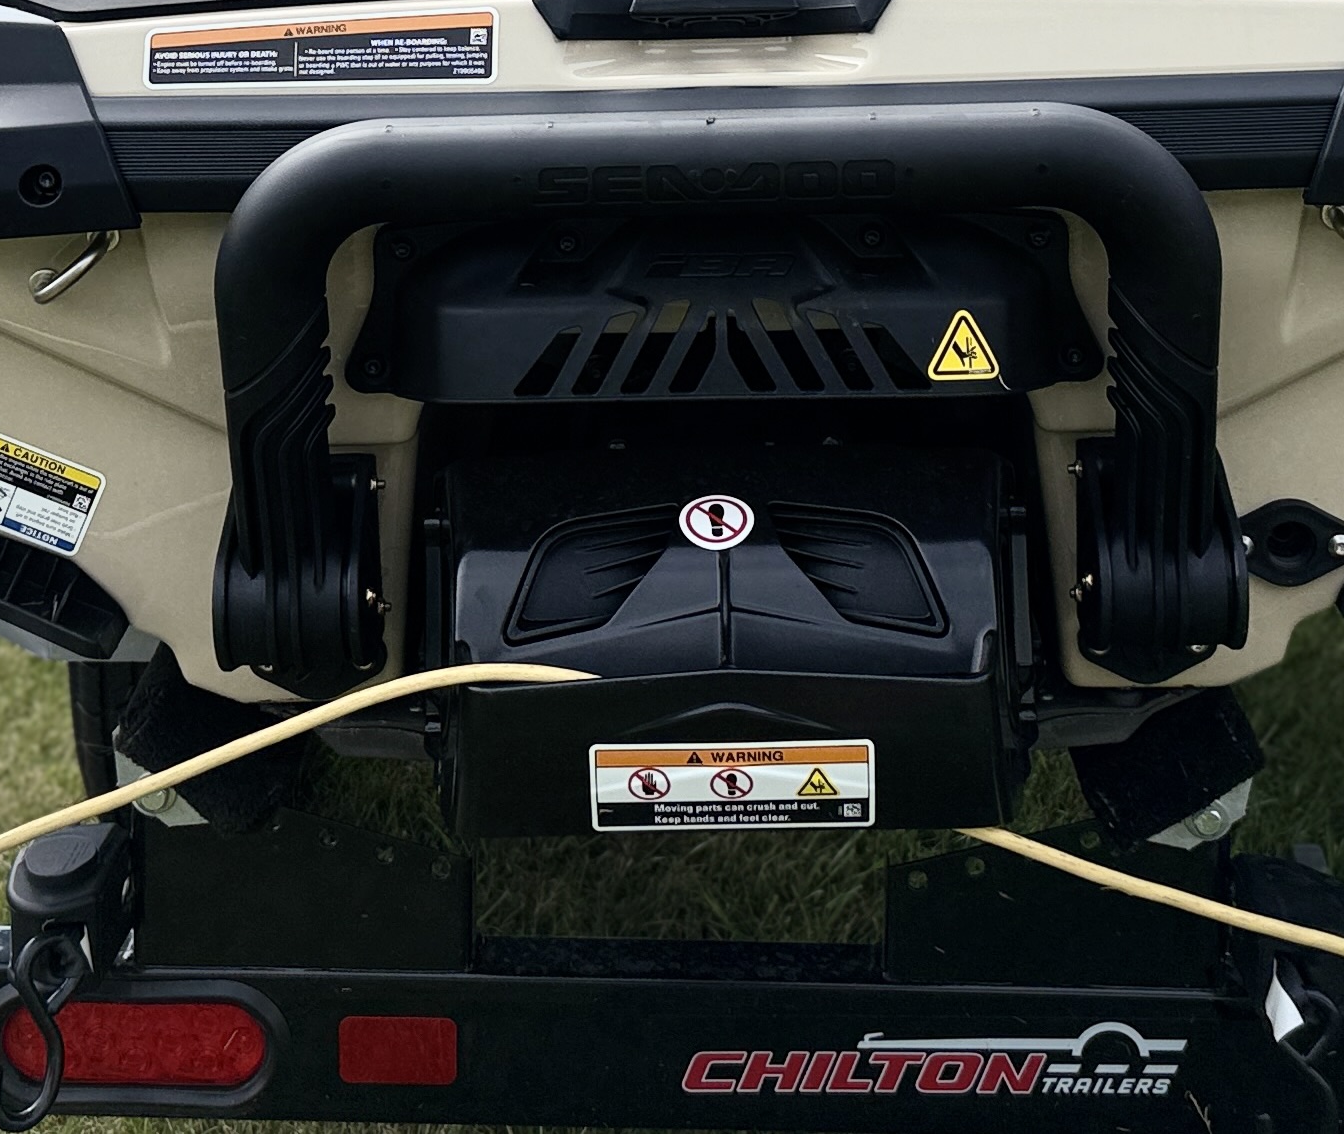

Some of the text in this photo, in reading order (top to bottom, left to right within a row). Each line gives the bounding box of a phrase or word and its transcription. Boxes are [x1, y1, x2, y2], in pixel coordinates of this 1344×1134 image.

[296, 24, 347, 35] WARNING
[13, 445, 67, 475] CAUTION
[19, 524, 58, 545] NOTICE
[711, 751, 783, 763] WARNING
[654, 804, 693, 815] Moving
[696, 803, 722, 814] parts
[724, 804, 744, 812] can
[746, 802, 776, 812] crush
[778, 802, 798, 811] and
[654, 815, 681, 825] Keep
[683, 814, 715, 824] hands
[717, 815, 736, 823] and
[682, 1051, 1170, 1095] CHILTON TRAILERS
